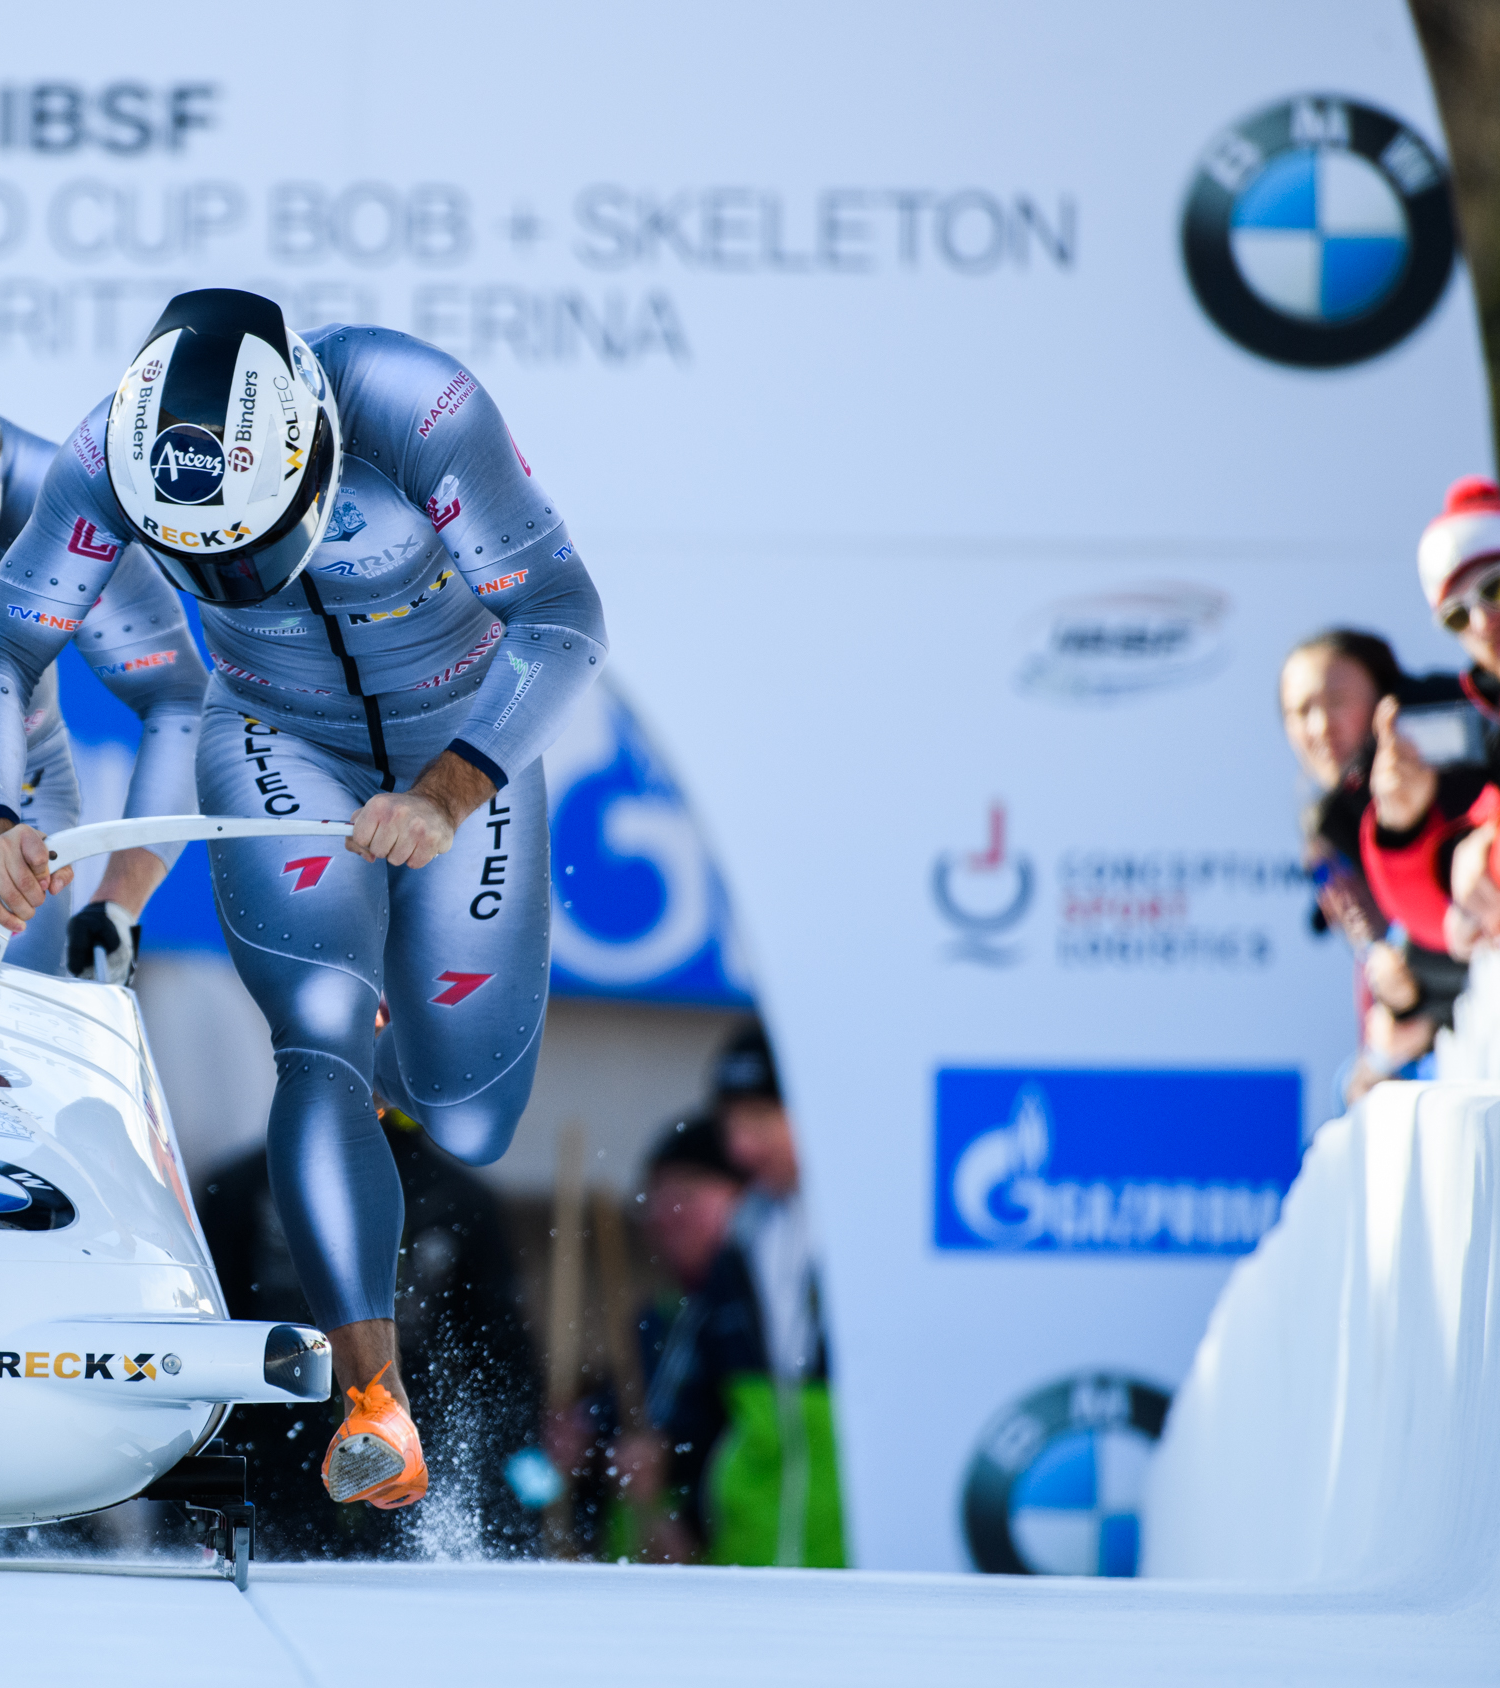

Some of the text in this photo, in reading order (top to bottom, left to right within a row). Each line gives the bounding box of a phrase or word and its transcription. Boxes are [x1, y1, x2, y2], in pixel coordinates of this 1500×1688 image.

[48, 181, 244, 265] CUP
[266, 183, 474, 268] BOB
[573, 184, 1081, 273] SKELETON
[133, 386, 154, 461] Binders
[235, 370, 259, 442] Binders
[418, 370, 470, 439] MACHINE
[448, 382, 477, 416] RACEWEAR
